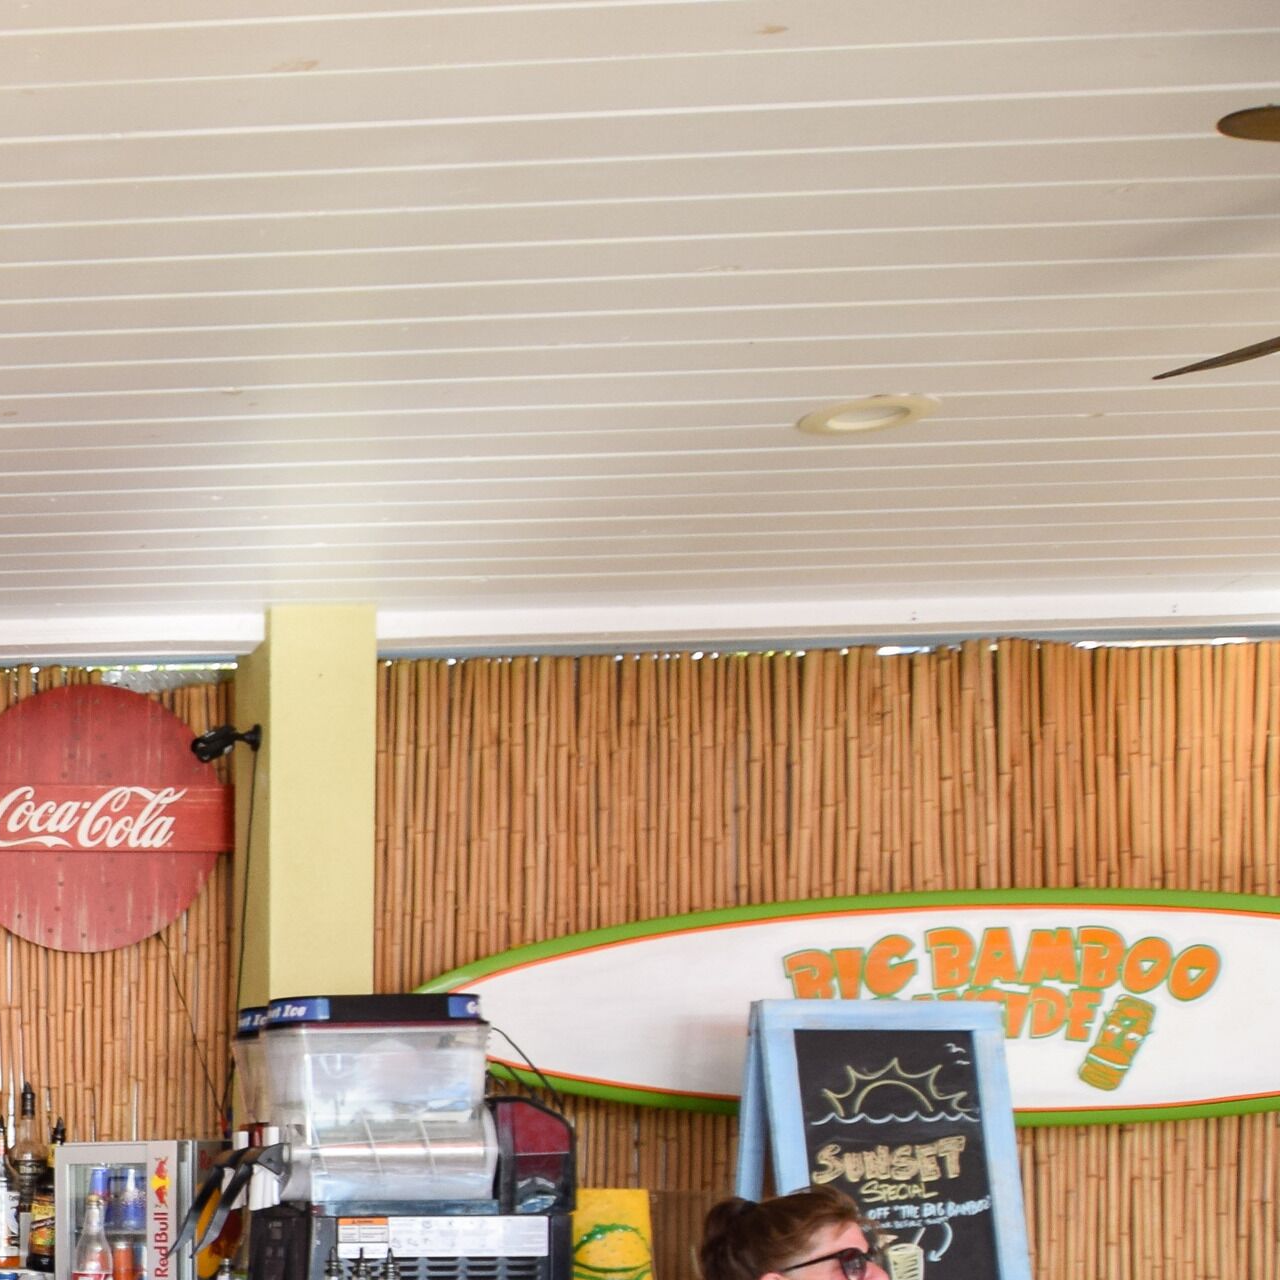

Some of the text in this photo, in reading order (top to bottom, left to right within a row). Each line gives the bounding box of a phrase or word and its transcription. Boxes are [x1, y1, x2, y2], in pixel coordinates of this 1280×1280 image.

[782, 925, 1221, 1002] BIG BAMBOO
[282, 1003, 307, 1017] Ice
[812, 1135, 966, 1184] SUNSET
[860, 1180, 939, 1203] SPECIAL
